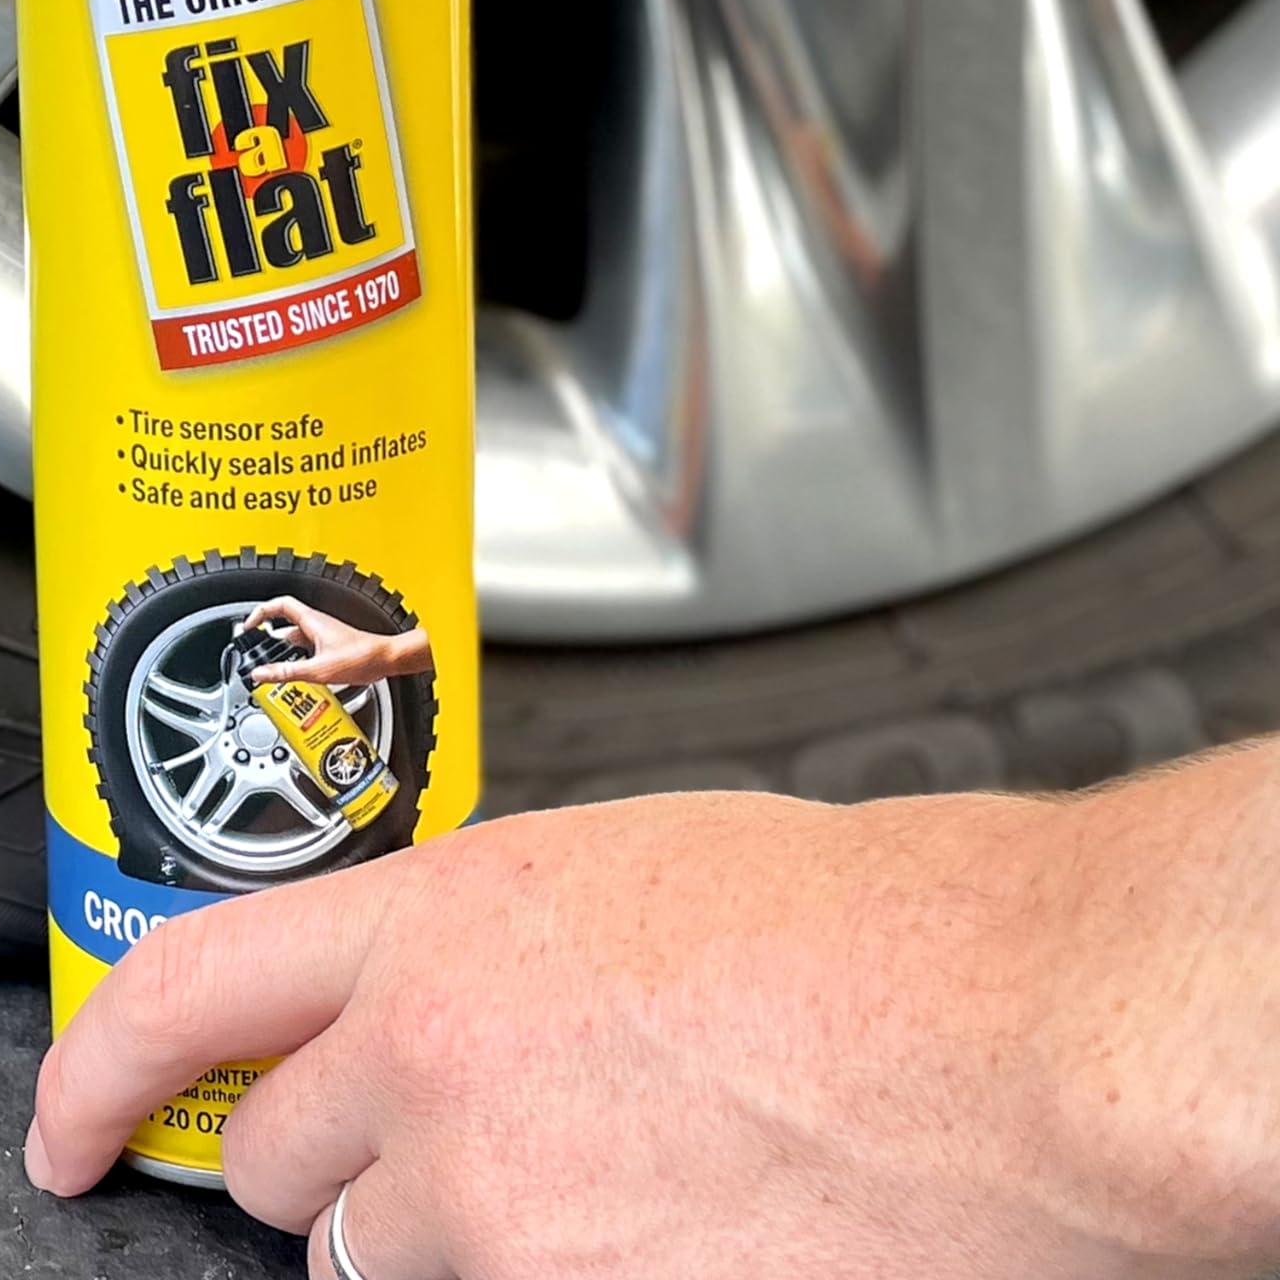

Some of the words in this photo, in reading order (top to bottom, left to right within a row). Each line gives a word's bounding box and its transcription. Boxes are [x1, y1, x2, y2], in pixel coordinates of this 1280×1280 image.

[162, 37, 330, 160] fix
[233, 125, 288, 178] a
[182, 309, 284, 357] TRUSTED
[290, 287, 353, 336] SINCE
[354, 270, 401, 314] 1970
[128, 408, 174, 437] Tire
[180, 418, 265, 441] sensor
[270, 413, 324, 441] safe
[131, 443, 222, 481] Quickly
[229, 451, 294, 476] seals
[300, 445, 345, 473] and
[351, 429, 427, 467] inflates
[131, 477, 184, 508] Safe
[190, 486, 236, 510] and
[244, 488, 301, 515] easy
[308, 484, 332, 507] to
[339, 478, 377, 503] use
[163, 1105, 190, 1131] 20
[196, 1111, 228, 1136] OZ
